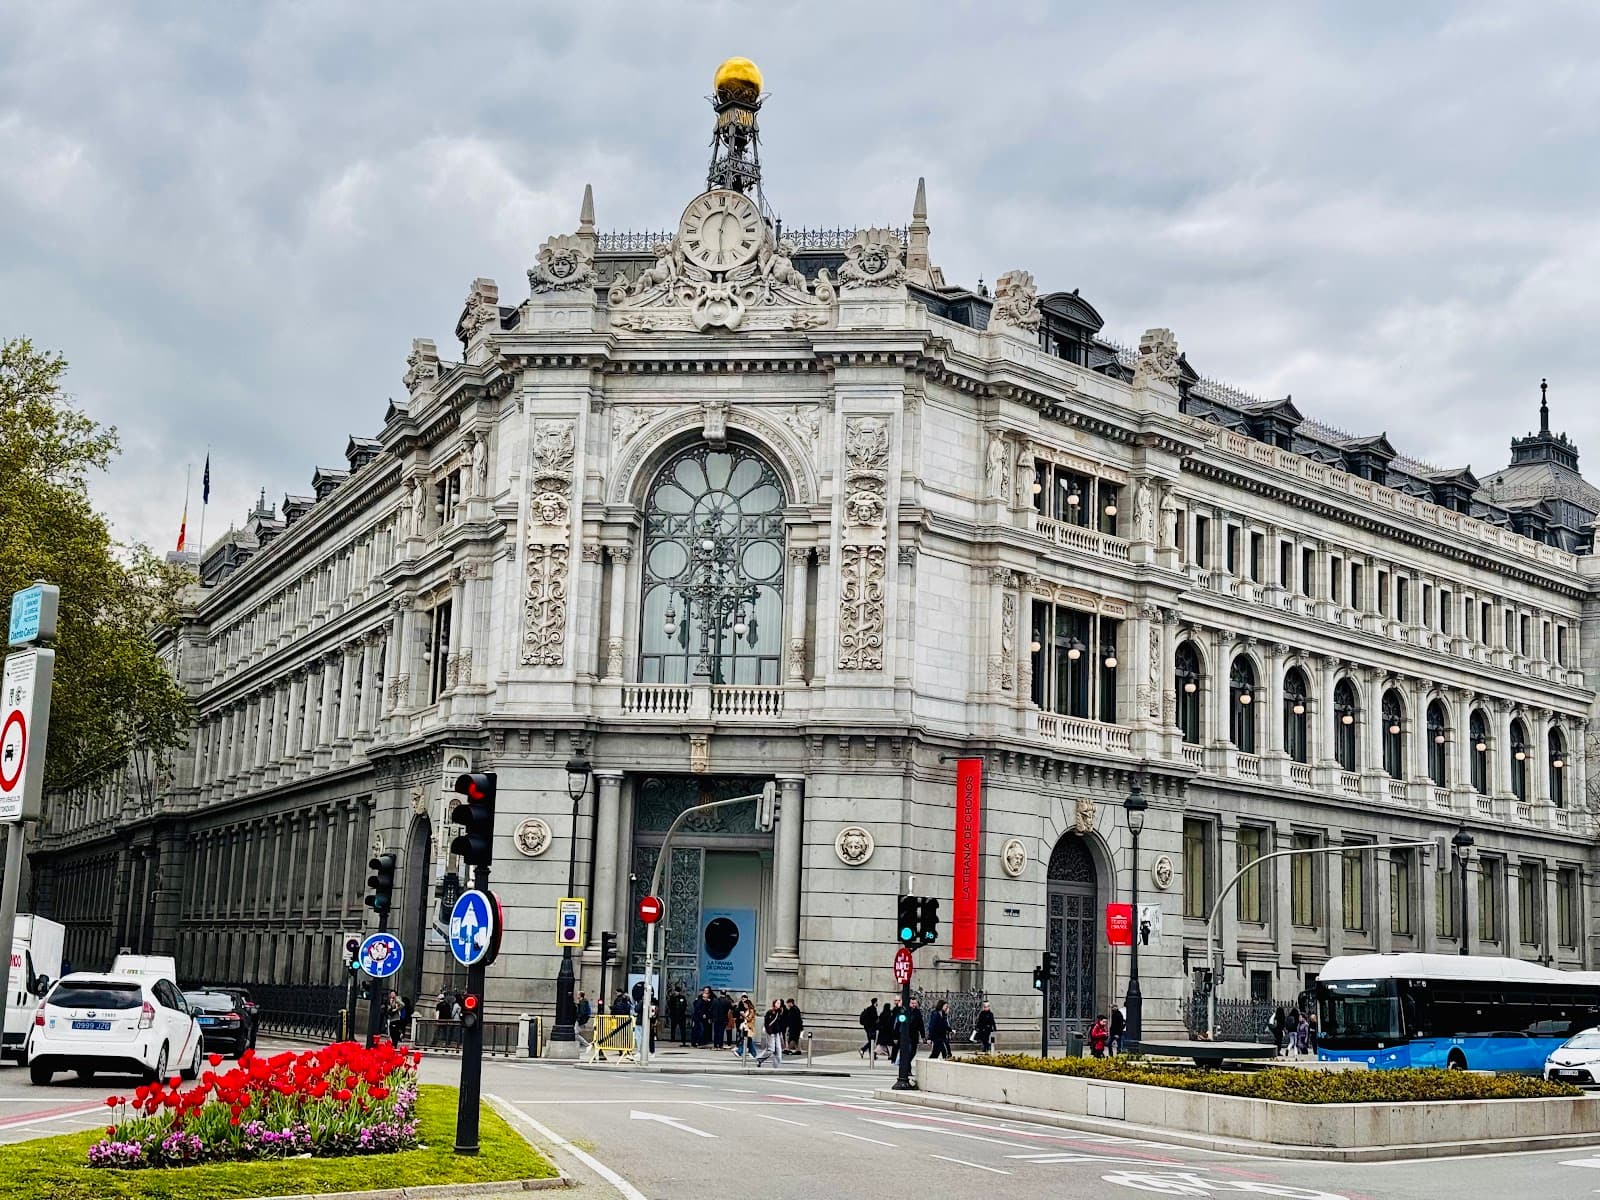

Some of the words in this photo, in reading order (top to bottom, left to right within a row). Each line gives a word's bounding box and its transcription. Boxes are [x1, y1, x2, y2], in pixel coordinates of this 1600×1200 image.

[965, 775, 973, 822] CRONOS
[964, 825, 972, 839] DE
[963, 886, 969, 900] LA
